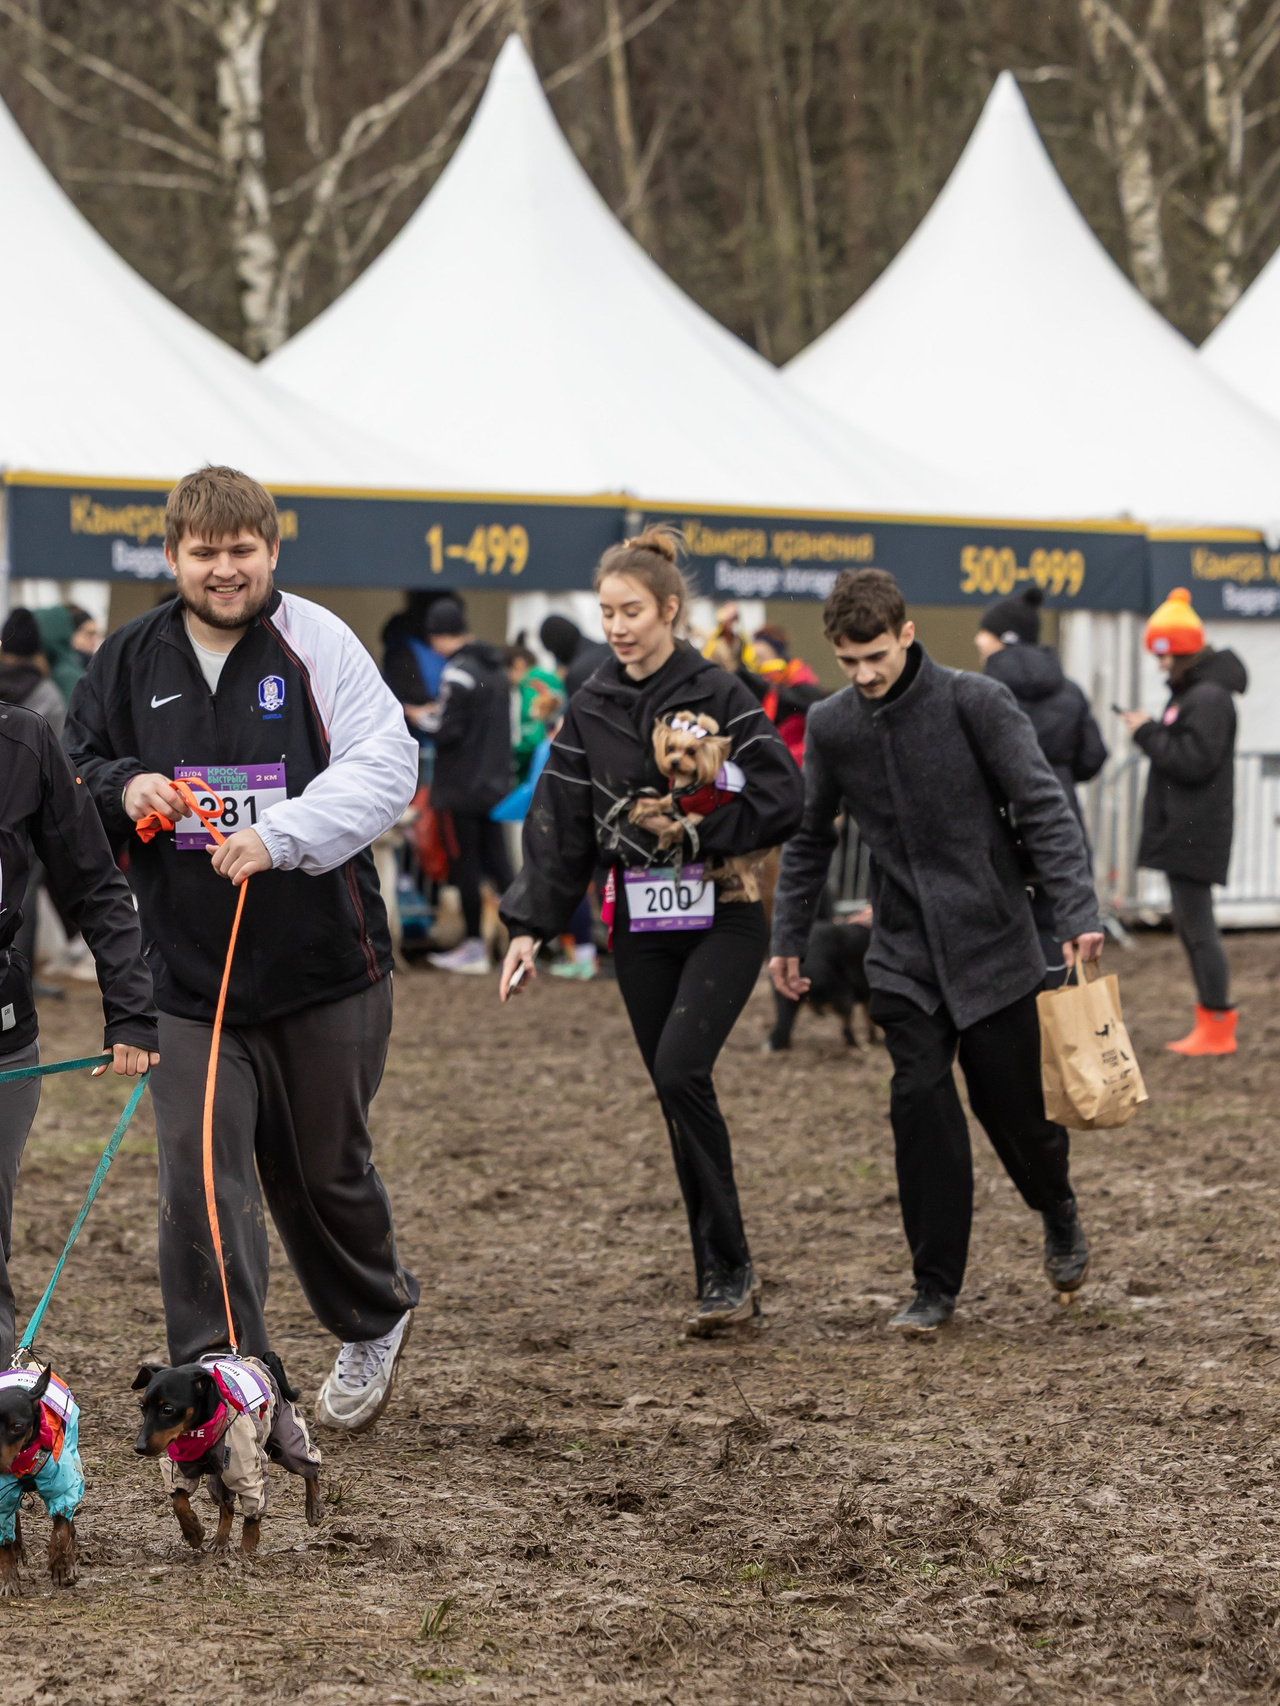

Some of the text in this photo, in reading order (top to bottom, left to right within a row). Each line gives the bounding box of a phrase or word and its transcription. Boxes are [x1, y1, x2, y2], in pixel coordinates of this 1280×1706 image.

[207, 767, 238, 776] КРОСС
[200, 795, 257, 828] 281
[645, 886, 692, 913] 200
